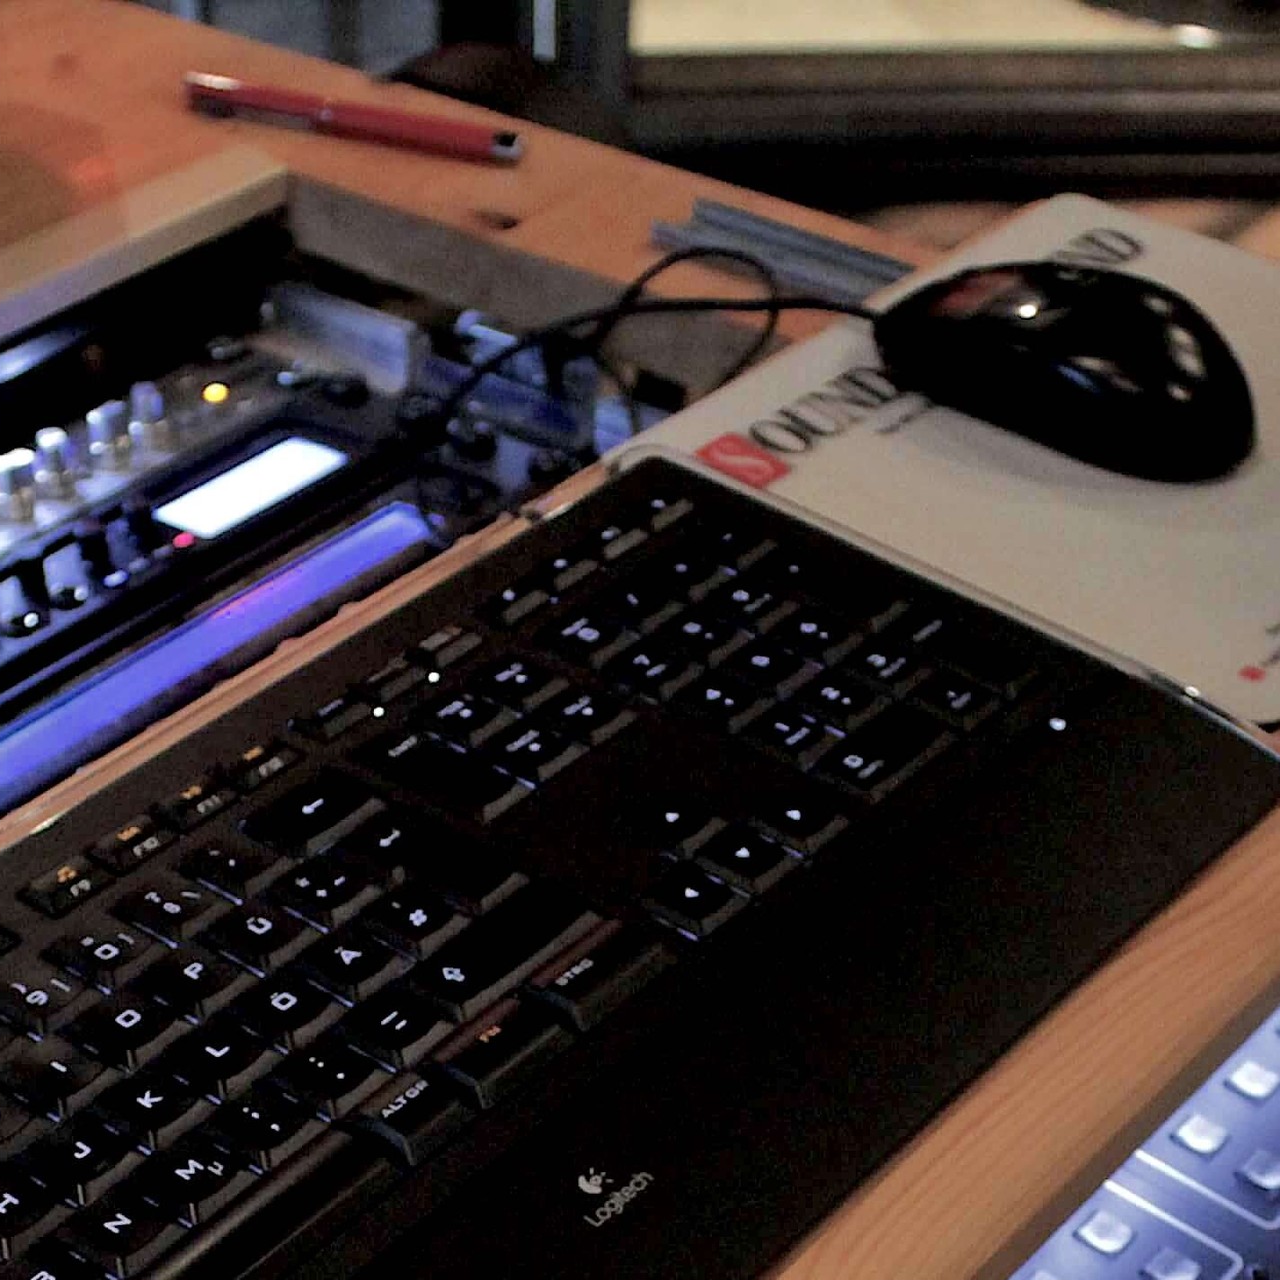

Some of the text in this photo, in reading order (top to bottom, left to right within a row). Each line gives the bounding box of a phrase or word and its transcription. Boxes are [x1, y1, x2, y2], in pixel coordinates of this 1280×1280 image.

[184, 963, 202, 979] P
[26, 991, 47, 1005] 9
[115, 1010, 141, 1027] O
[206, 1047, 229, 1057] L
[137, 1091, 162, 1108] K
[74, 1142, 91, 1158] J
[175, 1160, 203, 1180] M
[583, 1172, 654, 1226] Logitech
[104, 1214, 131, 1233] N
